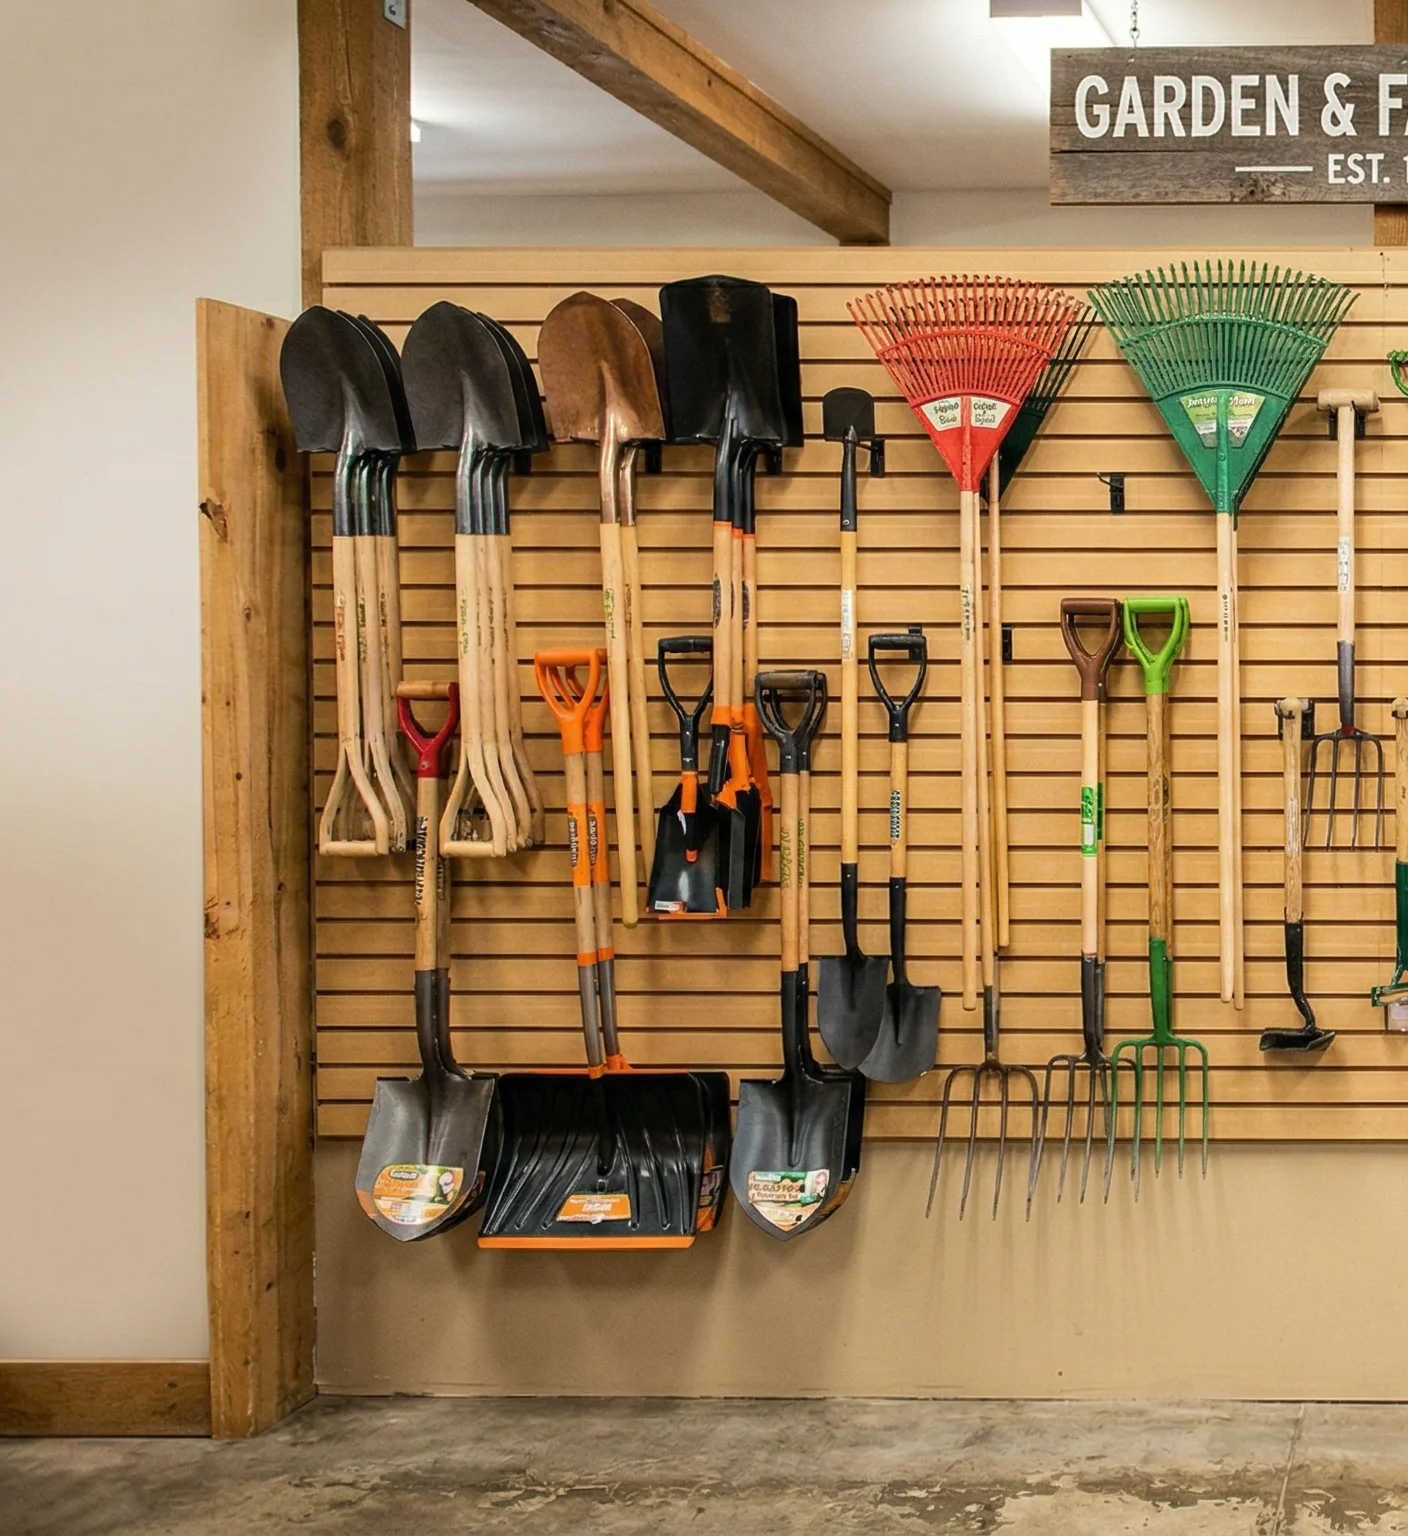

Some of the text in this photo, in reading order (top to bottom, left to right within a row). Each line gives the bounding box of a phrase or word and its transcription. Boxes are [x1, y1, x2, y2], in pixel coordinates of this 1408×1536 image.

[1075, 74, 1299, 138] GARDEN
[1320, 72, 1358, 137] &
[1328, 153, 1390, 184] EST.
